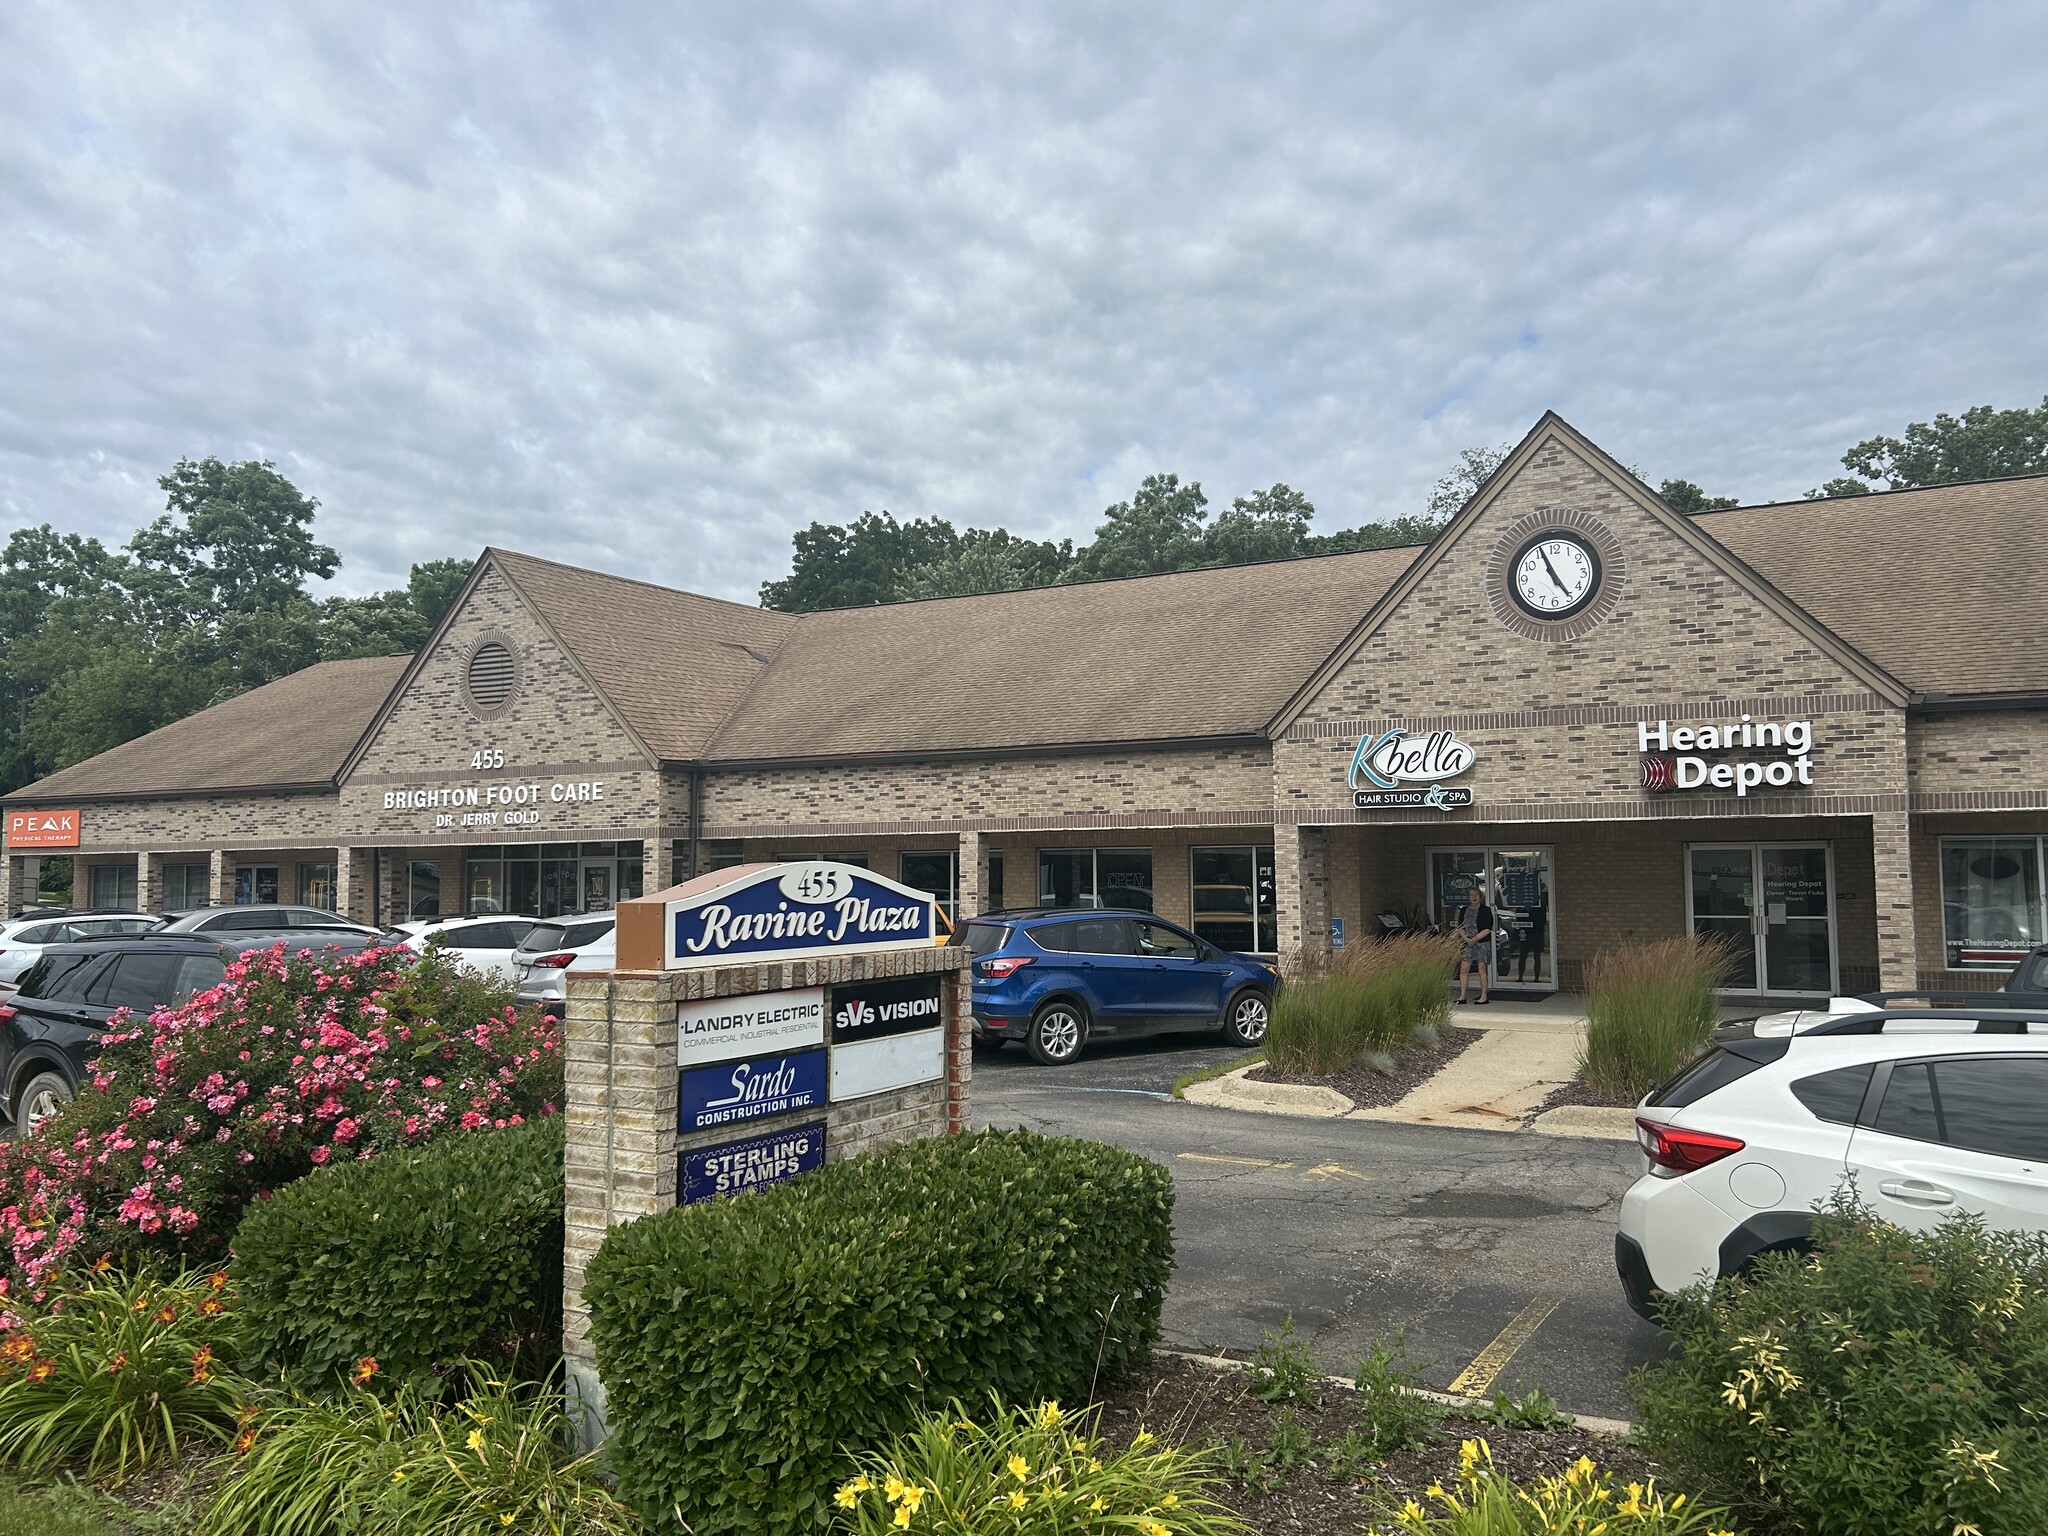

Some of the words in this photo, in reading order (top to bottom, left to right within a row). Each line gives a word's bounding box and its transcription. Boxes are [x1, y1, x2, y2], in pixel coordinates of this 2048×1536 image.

[1549, 544, 1560, 554] 12
[1525, 561, 1536, 571] 10
[1575, 554, 1582, 564] 2
[1521, 575, 1528, 585] 9
[1580, 568, 1587, 578] 3
[1528, 588, 1535, 598] 8
[1575, 581, 1582, 590] 4
[1539, 596, 1546, 605] 7
[1551, 597, 1559, 607] 6
[1566, 592, 1573, 602] 5
[1638, 714, 1812, 755] Hearing
[470, 750, 505, 770] 455
[1676, 755, 1813, 796] Depot
[384, 788, 478, 809] BRIGHTON
[486, 785, 540, 804] FOOT
[550, 782, 604, 802] CARE
[1359, 794, 1381, 804] HAIR
[1384, 793, 1421, 803] STUDIO
[1448, 792, 1467, 802] SPA
[13, 816, 72, 832] PEAK
[436, 814, 455, 827] DR.
[460, 812, 499, 826] JERRY
[504, 810, 539, 825] GOLD
[798, 870, 838, 898] 455
[1110, 873, 1141, 887] OPEN
[1767, 880, 1797, 889] Hearing
[1798, 880, 1822, 888] Depot
[686, 901, 824, 952] Ravine
[826, 897, 920, 942] Plaza
[1946, 939, 2042, 948] www.TheHearingDepot.com
[879, 997, 939, 1021] VISION
[684, 1013, 755, 1034] LANDRY
[757, 1004, 819, 1025] ELECTRIC
[683, 1034, 739, 1048] COMMERCIAL
[740, 1027, 780, 1040] INDUSTRIAL
[781, 1021, 820, 1034] RESIDENTIAL
[706, 1058, 796, 1107] Sardo
[696, 1101, 786, 1127] CONSTRUCTION
[791, 1094, 814, 1108] INC.
[705, 1138, 809, 1176] STERLING
[715, 1156, 800, 1191] STAMPS
